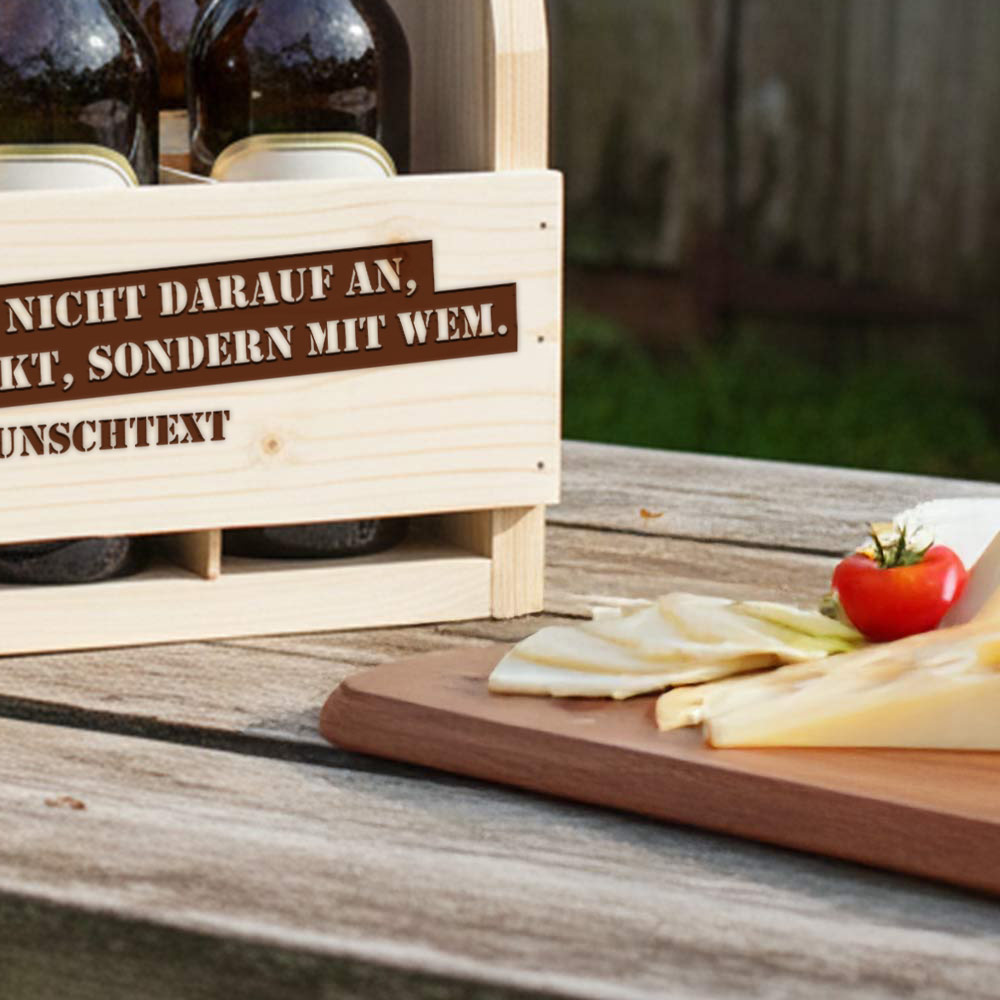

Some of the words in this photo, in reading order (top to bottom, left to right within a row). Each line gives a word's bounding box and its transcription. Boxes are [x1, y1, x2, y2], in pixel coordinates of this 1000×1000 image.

[4, 284, 147, 334] NICHT
[158, 264, 335, 318] DARAUF
[345, 257, 418, 297] AN,
[87, 324, 296, 383] SONDERN
[306, 315, 387, 357] MIT
[396, 303, 509, 347] WEM.
